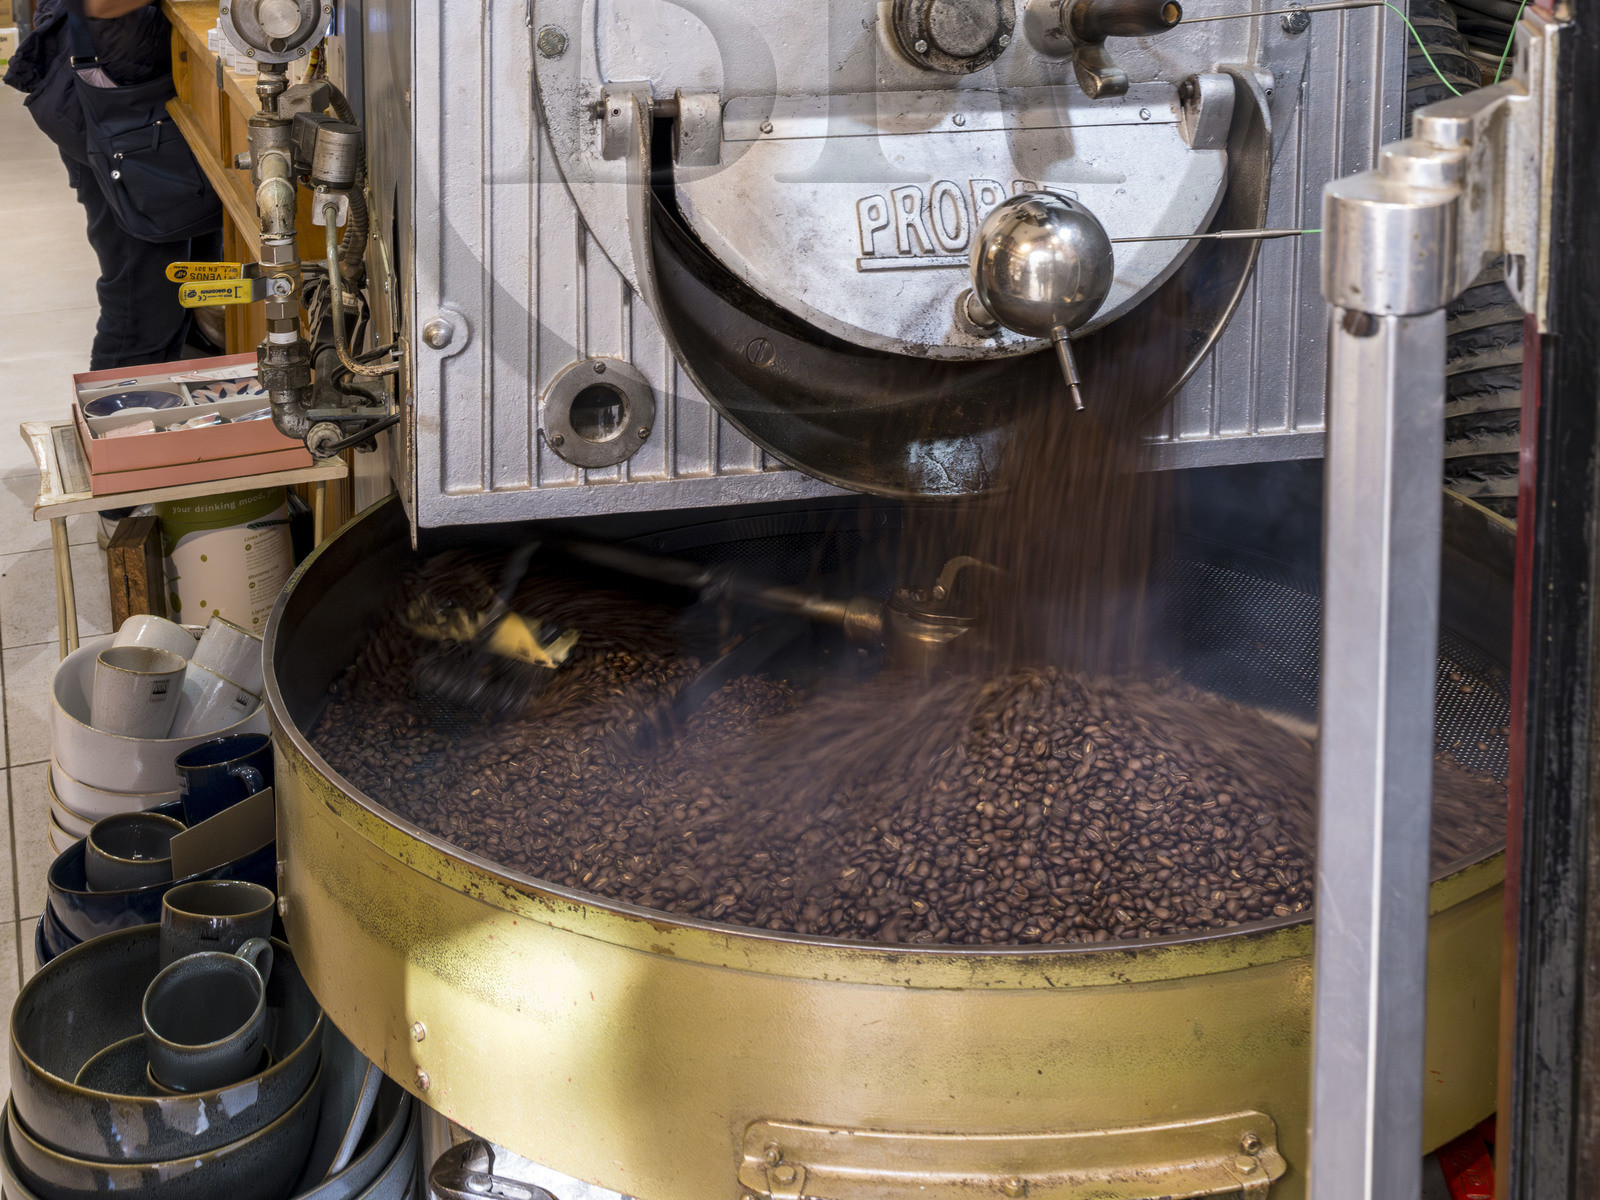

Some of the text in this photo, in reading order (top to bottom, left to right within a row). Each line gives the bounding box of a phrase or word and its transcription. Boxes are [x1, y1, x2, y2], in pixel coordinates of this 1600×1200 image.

[855, 178, 1079, 256] PROB
[190, 273, 222, 281] VENUS
[172, 493, 265, 514] your drinking mood.
